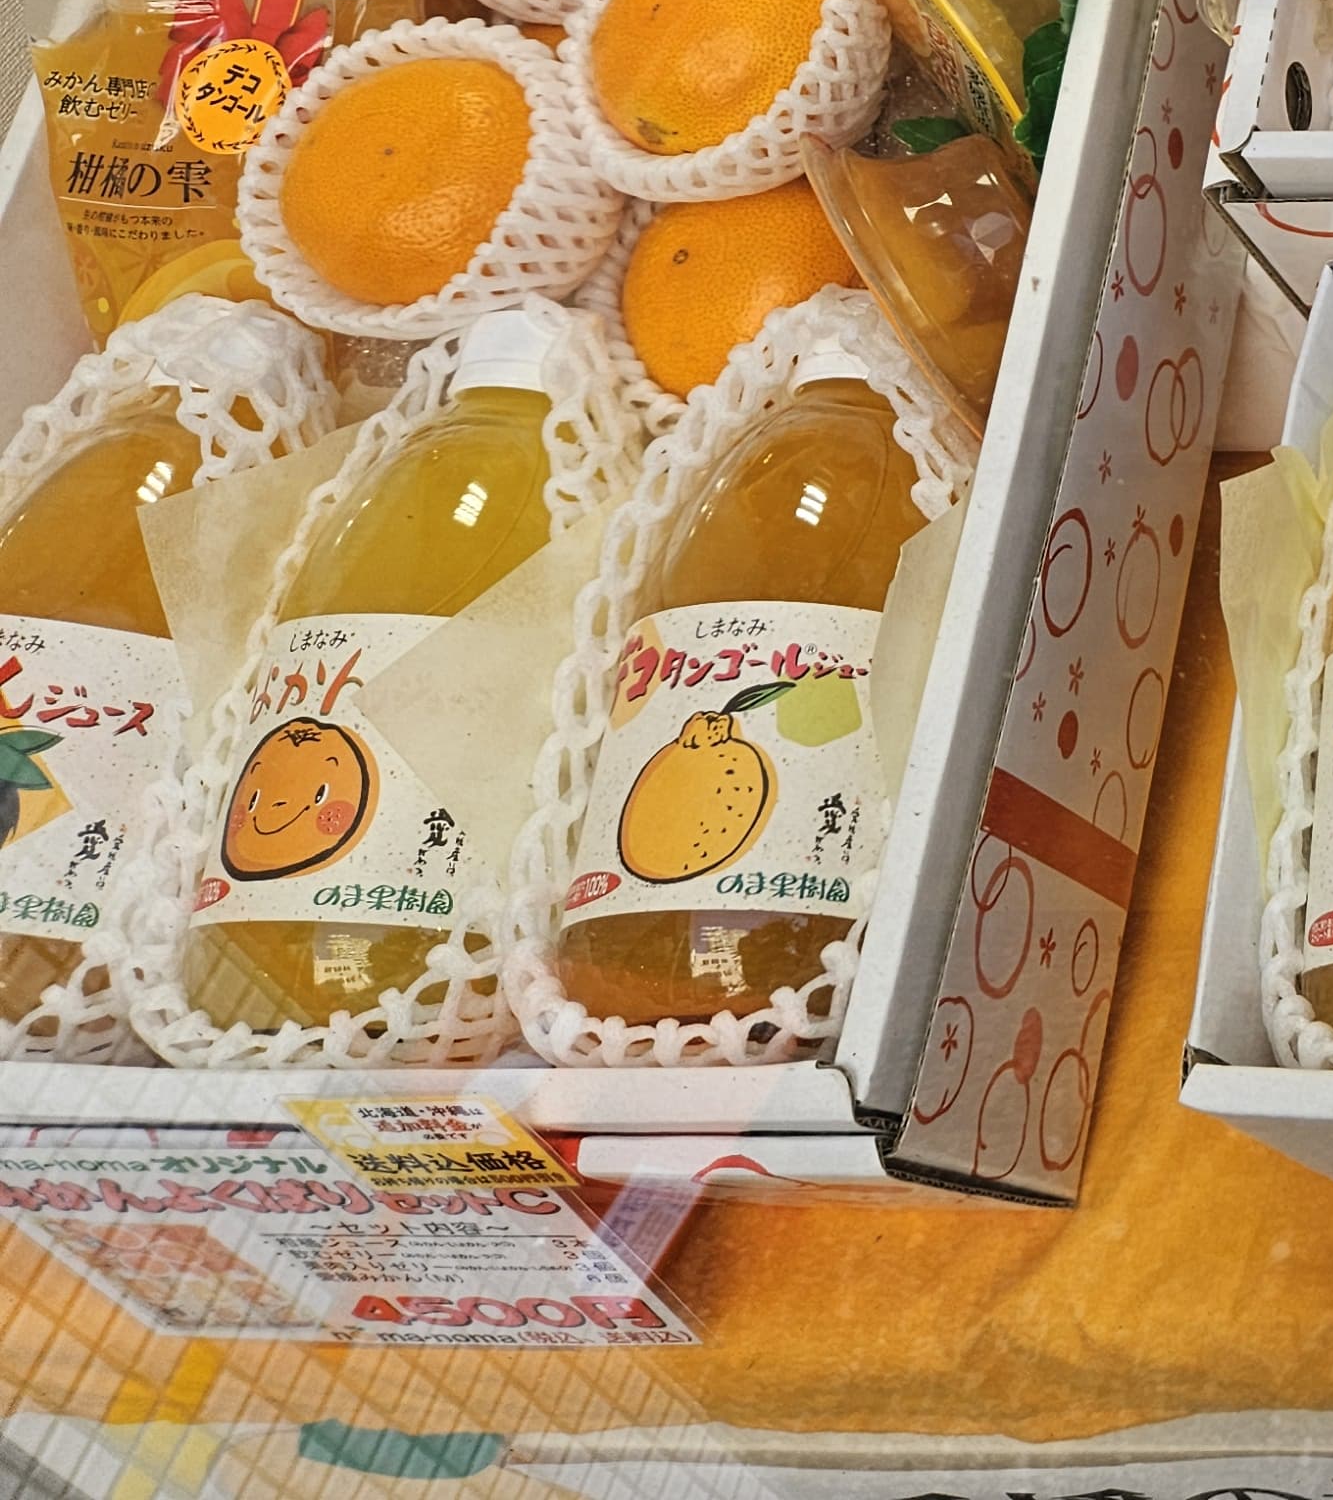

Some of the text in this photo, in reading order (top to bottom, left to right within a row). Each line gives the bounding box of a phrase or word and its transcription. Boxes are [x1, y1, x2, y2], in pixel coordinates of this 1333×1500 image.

[223, 63, 263, 95] デコ
[58, 94, 139, 123] 飲むゼリー
[195, 81, 266, 124] タンゴール
[66, 150, 213, 204] 柑橘の雫
[289, 627, 349, 653] しまなみ
[695, 617, 768, 640] しまなみ
[813, 651, 873, 680] ジュー
[312, 882, 455, 916] のま果樹園
[716, 872, 850, 903] のま果樹園
[150, 1155, 329, 1174] オリジナル
[346, 1150, 547, 1175] 送料込価格
[352, 1295, 668, 1330] 4500円
